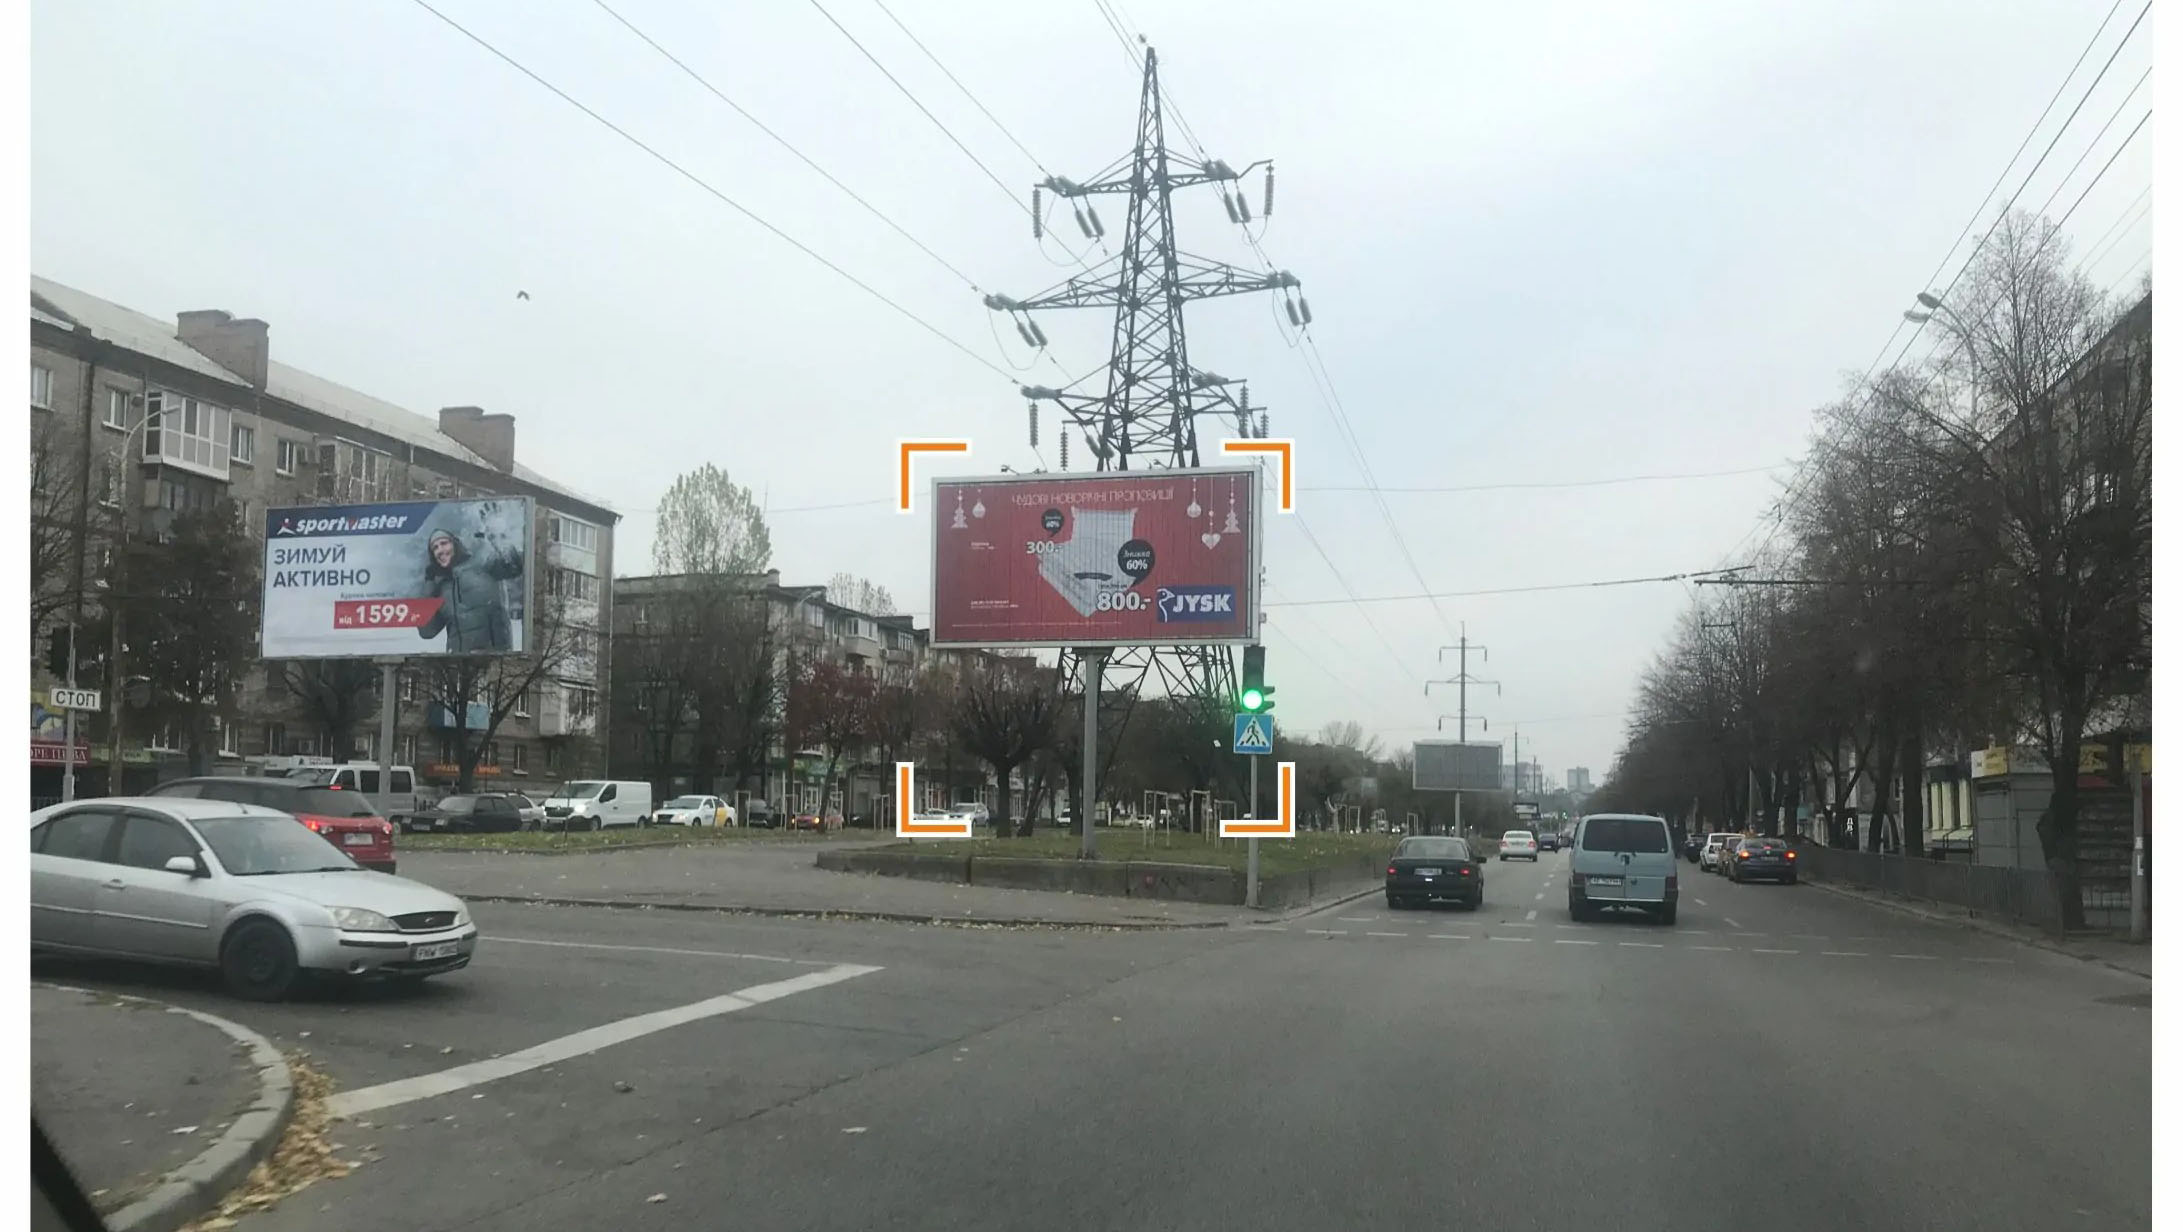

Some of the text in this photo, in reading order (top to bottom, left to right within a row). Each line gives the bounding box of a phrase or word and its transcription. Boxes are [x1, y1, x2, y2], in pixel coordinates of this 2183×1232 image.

[296, 514, 408, 535] sportmaster
[274, 543, 347, 566] ЗИМУЙ
[1126, 559, 1148, 570] 60%
[273, 568, 371, 589] АКТИВНО
[1172, 593, 1232, 613] JYSK
[356, 604, 409, 624] 1599
[55, 690, 96, 707] СТОП
